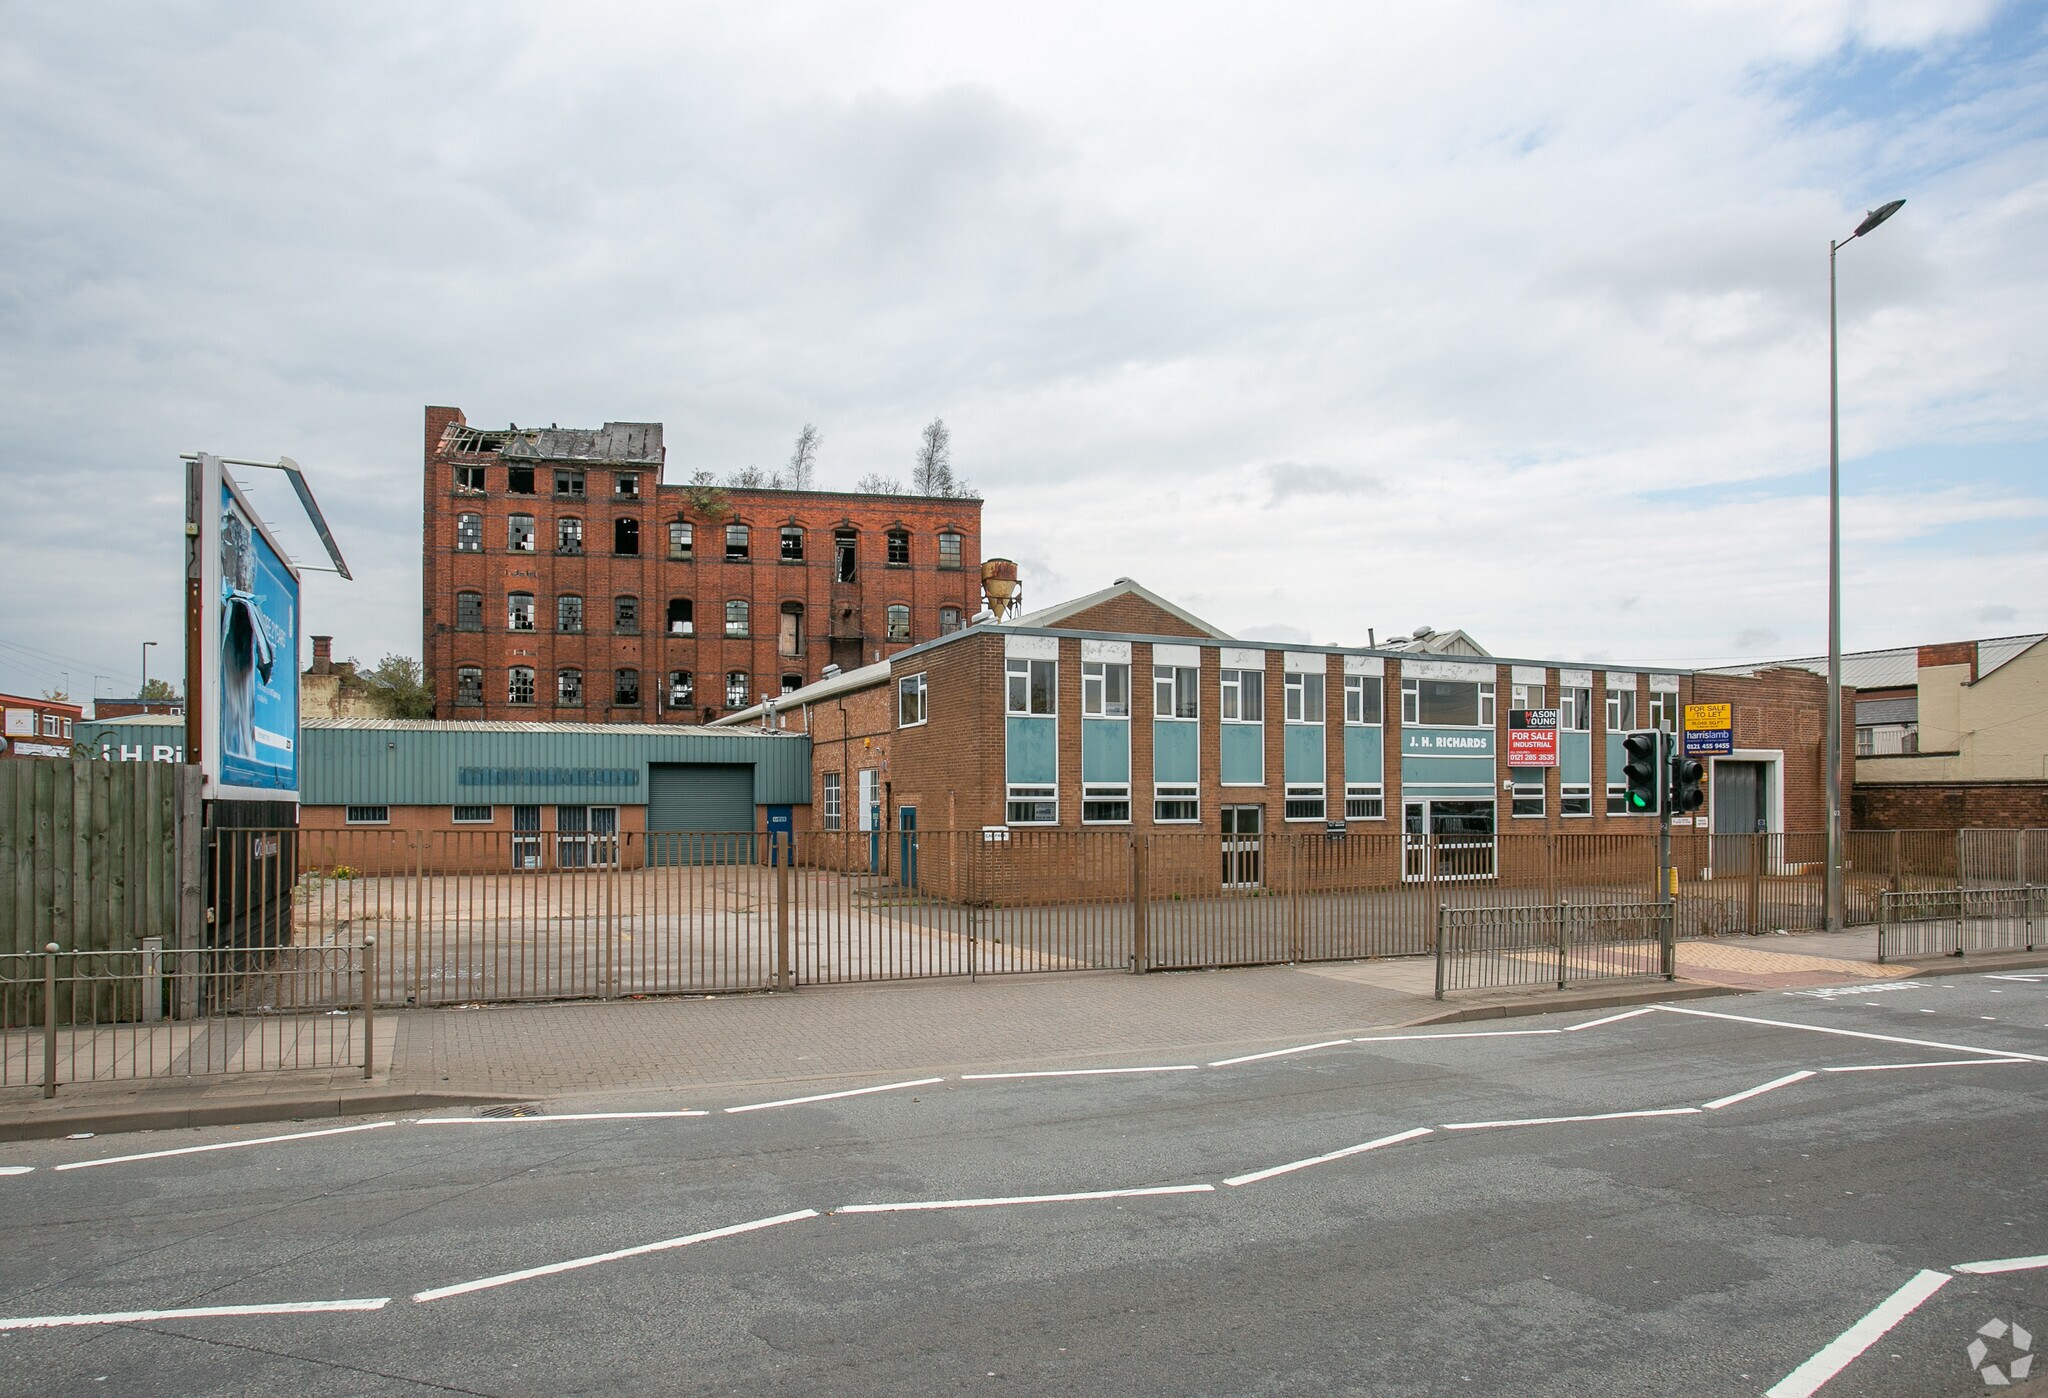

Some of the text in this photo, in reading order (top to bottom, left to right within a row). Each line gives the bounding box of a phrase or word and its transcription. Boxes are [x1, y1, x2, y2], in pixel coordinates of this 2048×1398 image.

[1525, 710, 1556, 718] MASON
[1511, 732, 1554, 740] FOR SALE
[1686, 730, 1729, 739] harrislamb
[1409, 736, 1487, 749] J. H. RICHARDS
[121, 745, 143, 762] H
[152, 745, 185, 764] Ri
